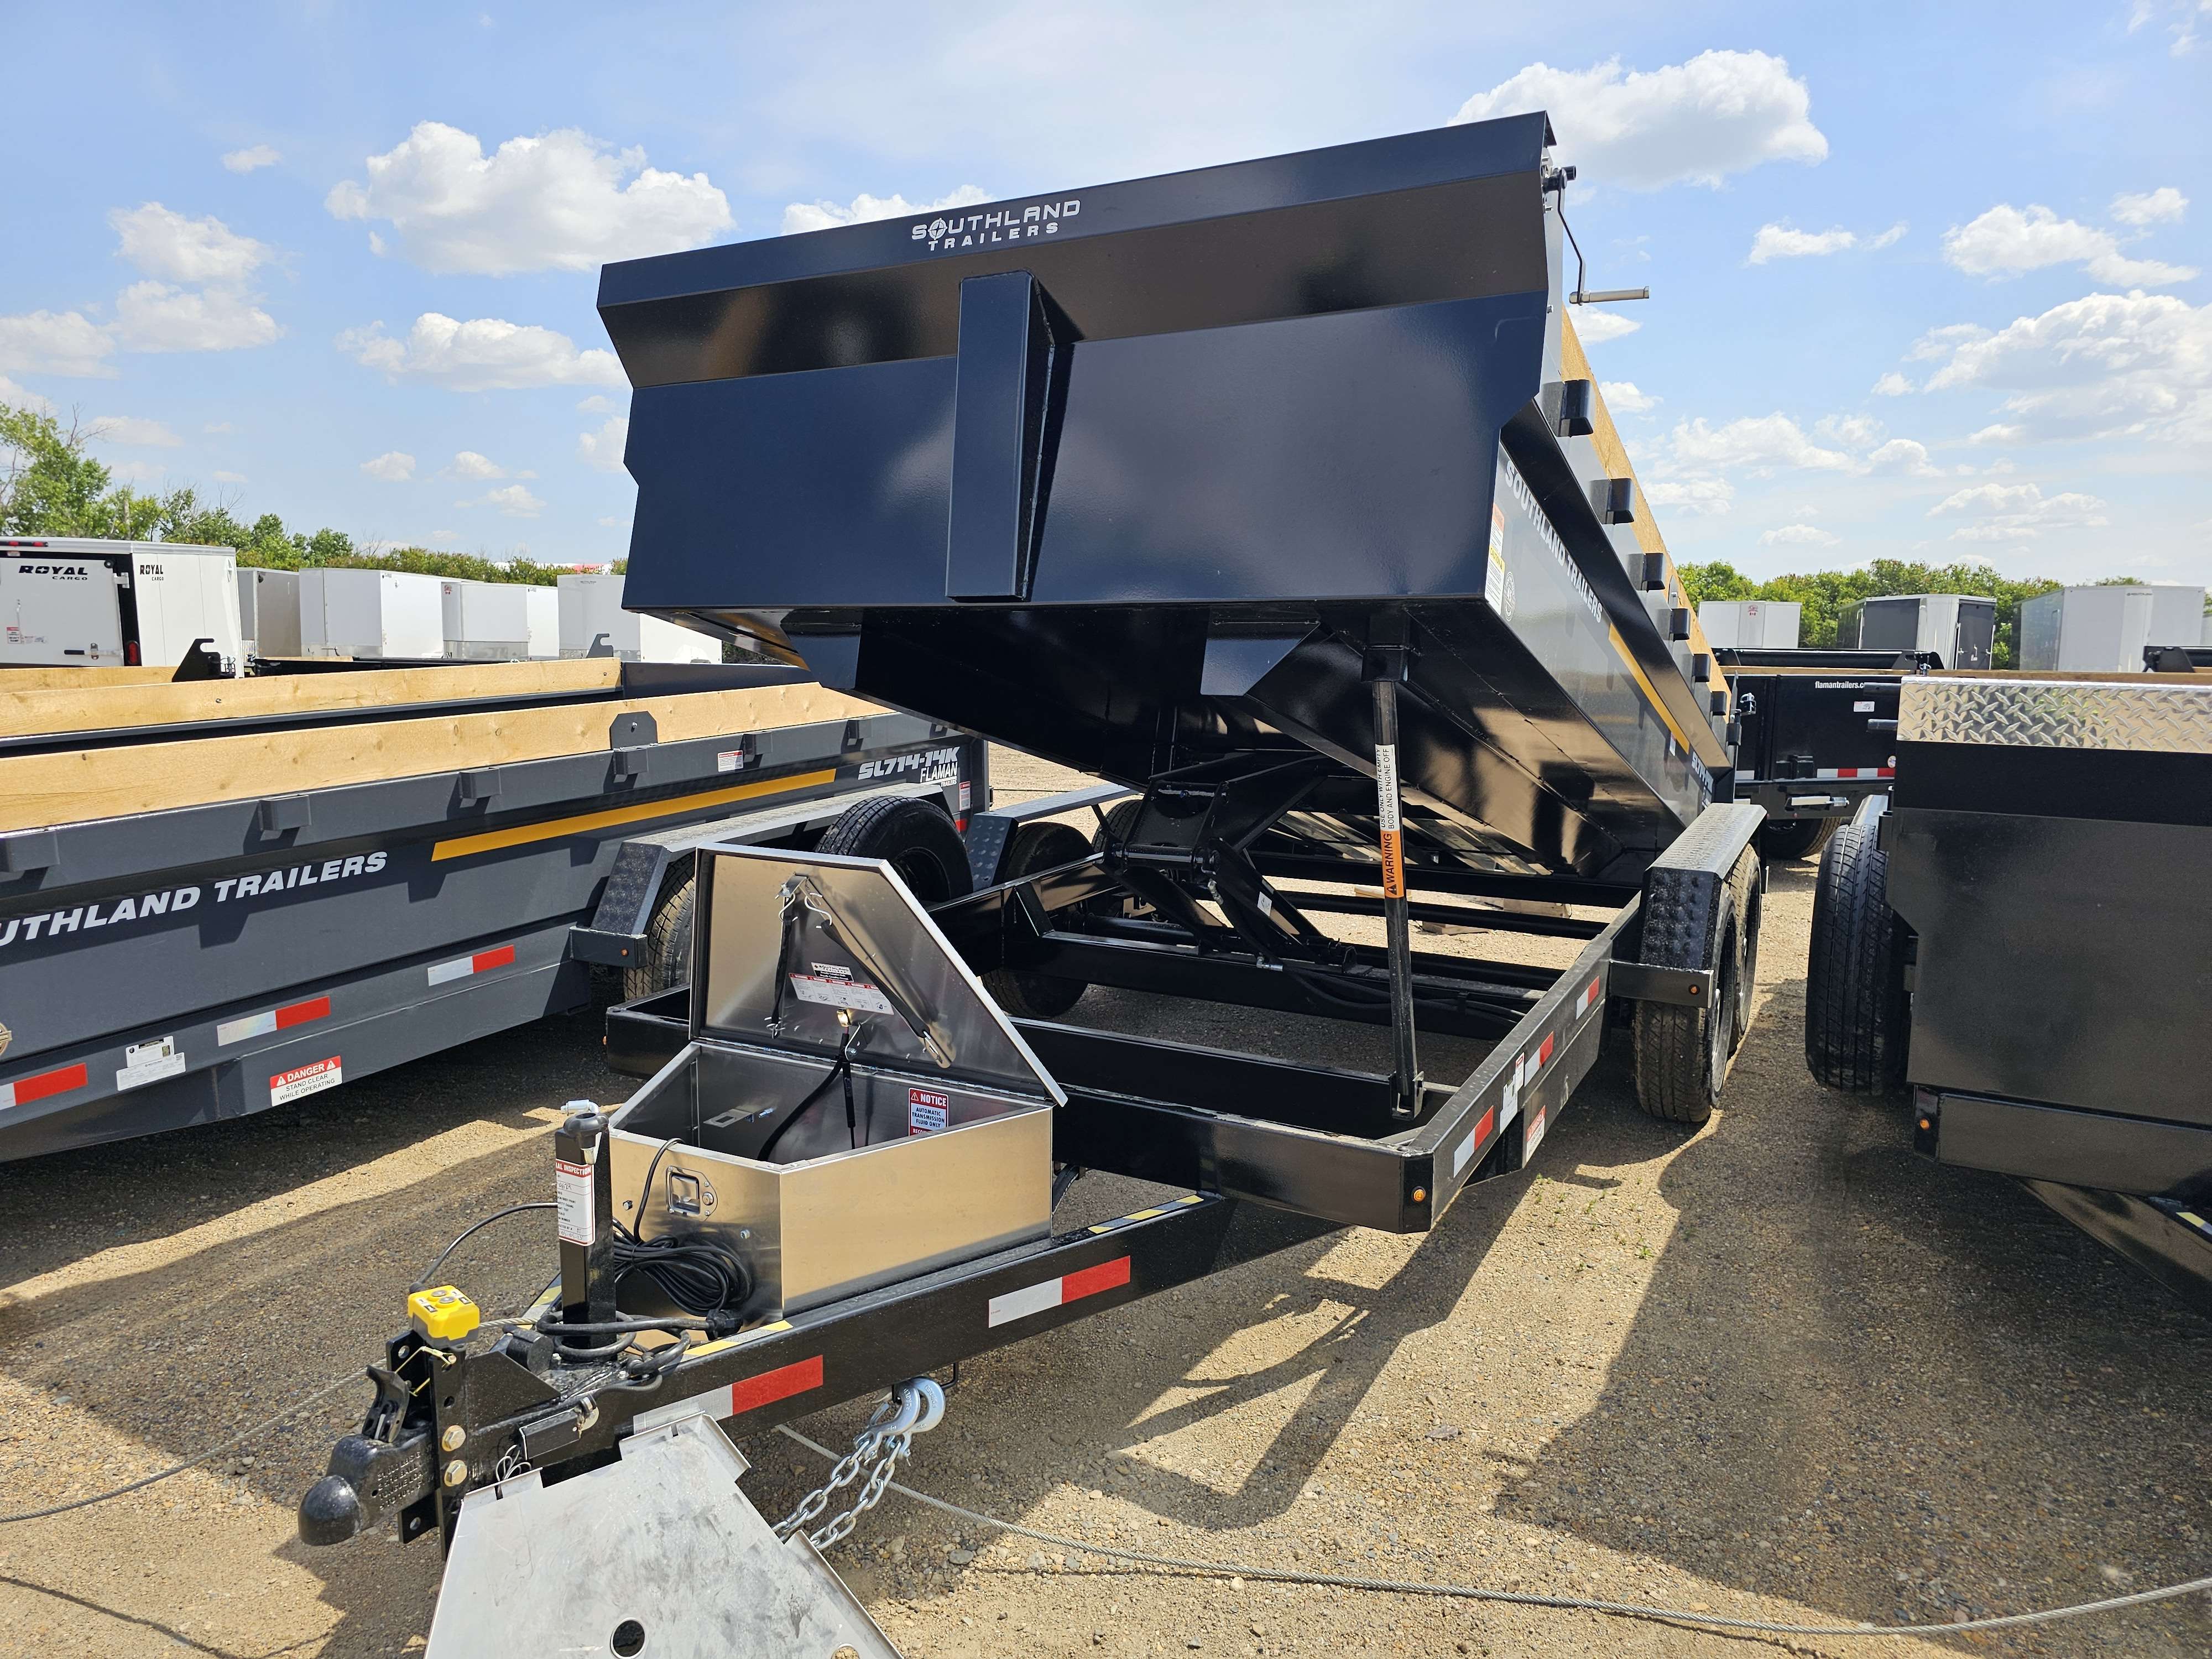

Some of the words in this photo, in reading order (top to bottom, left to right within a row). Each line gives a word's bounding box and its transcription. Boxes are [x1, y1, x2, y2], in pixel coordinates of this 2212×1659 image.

[912, 200, 1081, 240] SOUTHLAND
[928, 222, 1058, 251] TRAILERS
[1505, 460, 1566, 566] SOUTHLAND
[1566, 555, 1603, 623] TRAILERS
[18, 565, 88, 575] ROYAL
[140, 564, 164, 575] ROYAL
[858, 747, 961, 780] SL714-14K
[920, 761, 958, 783] FLAMAN
[941, 779, 957, 787] TRAILERS
[1384, 833, 1394, 883] WARNING
[214, 851, 388, 902] TRAILERS
[286, 1081, 306, 1091] STAND
[308, 1073, 328, 1084] CLEAR
[287, 1063, 325, 1082] DANGER
[279, 1090, 299, 1101] WHILE
[301, 1078, 335, 1093] OPERATING
[920, 1093, 947, 1107] NOTICE
[912, 1112, 945, 1123] TRANSMISSION
[916, 1107, 941, 1116] AUTOMATIC
[564, 1164, 592, 1176] INSPECTION
